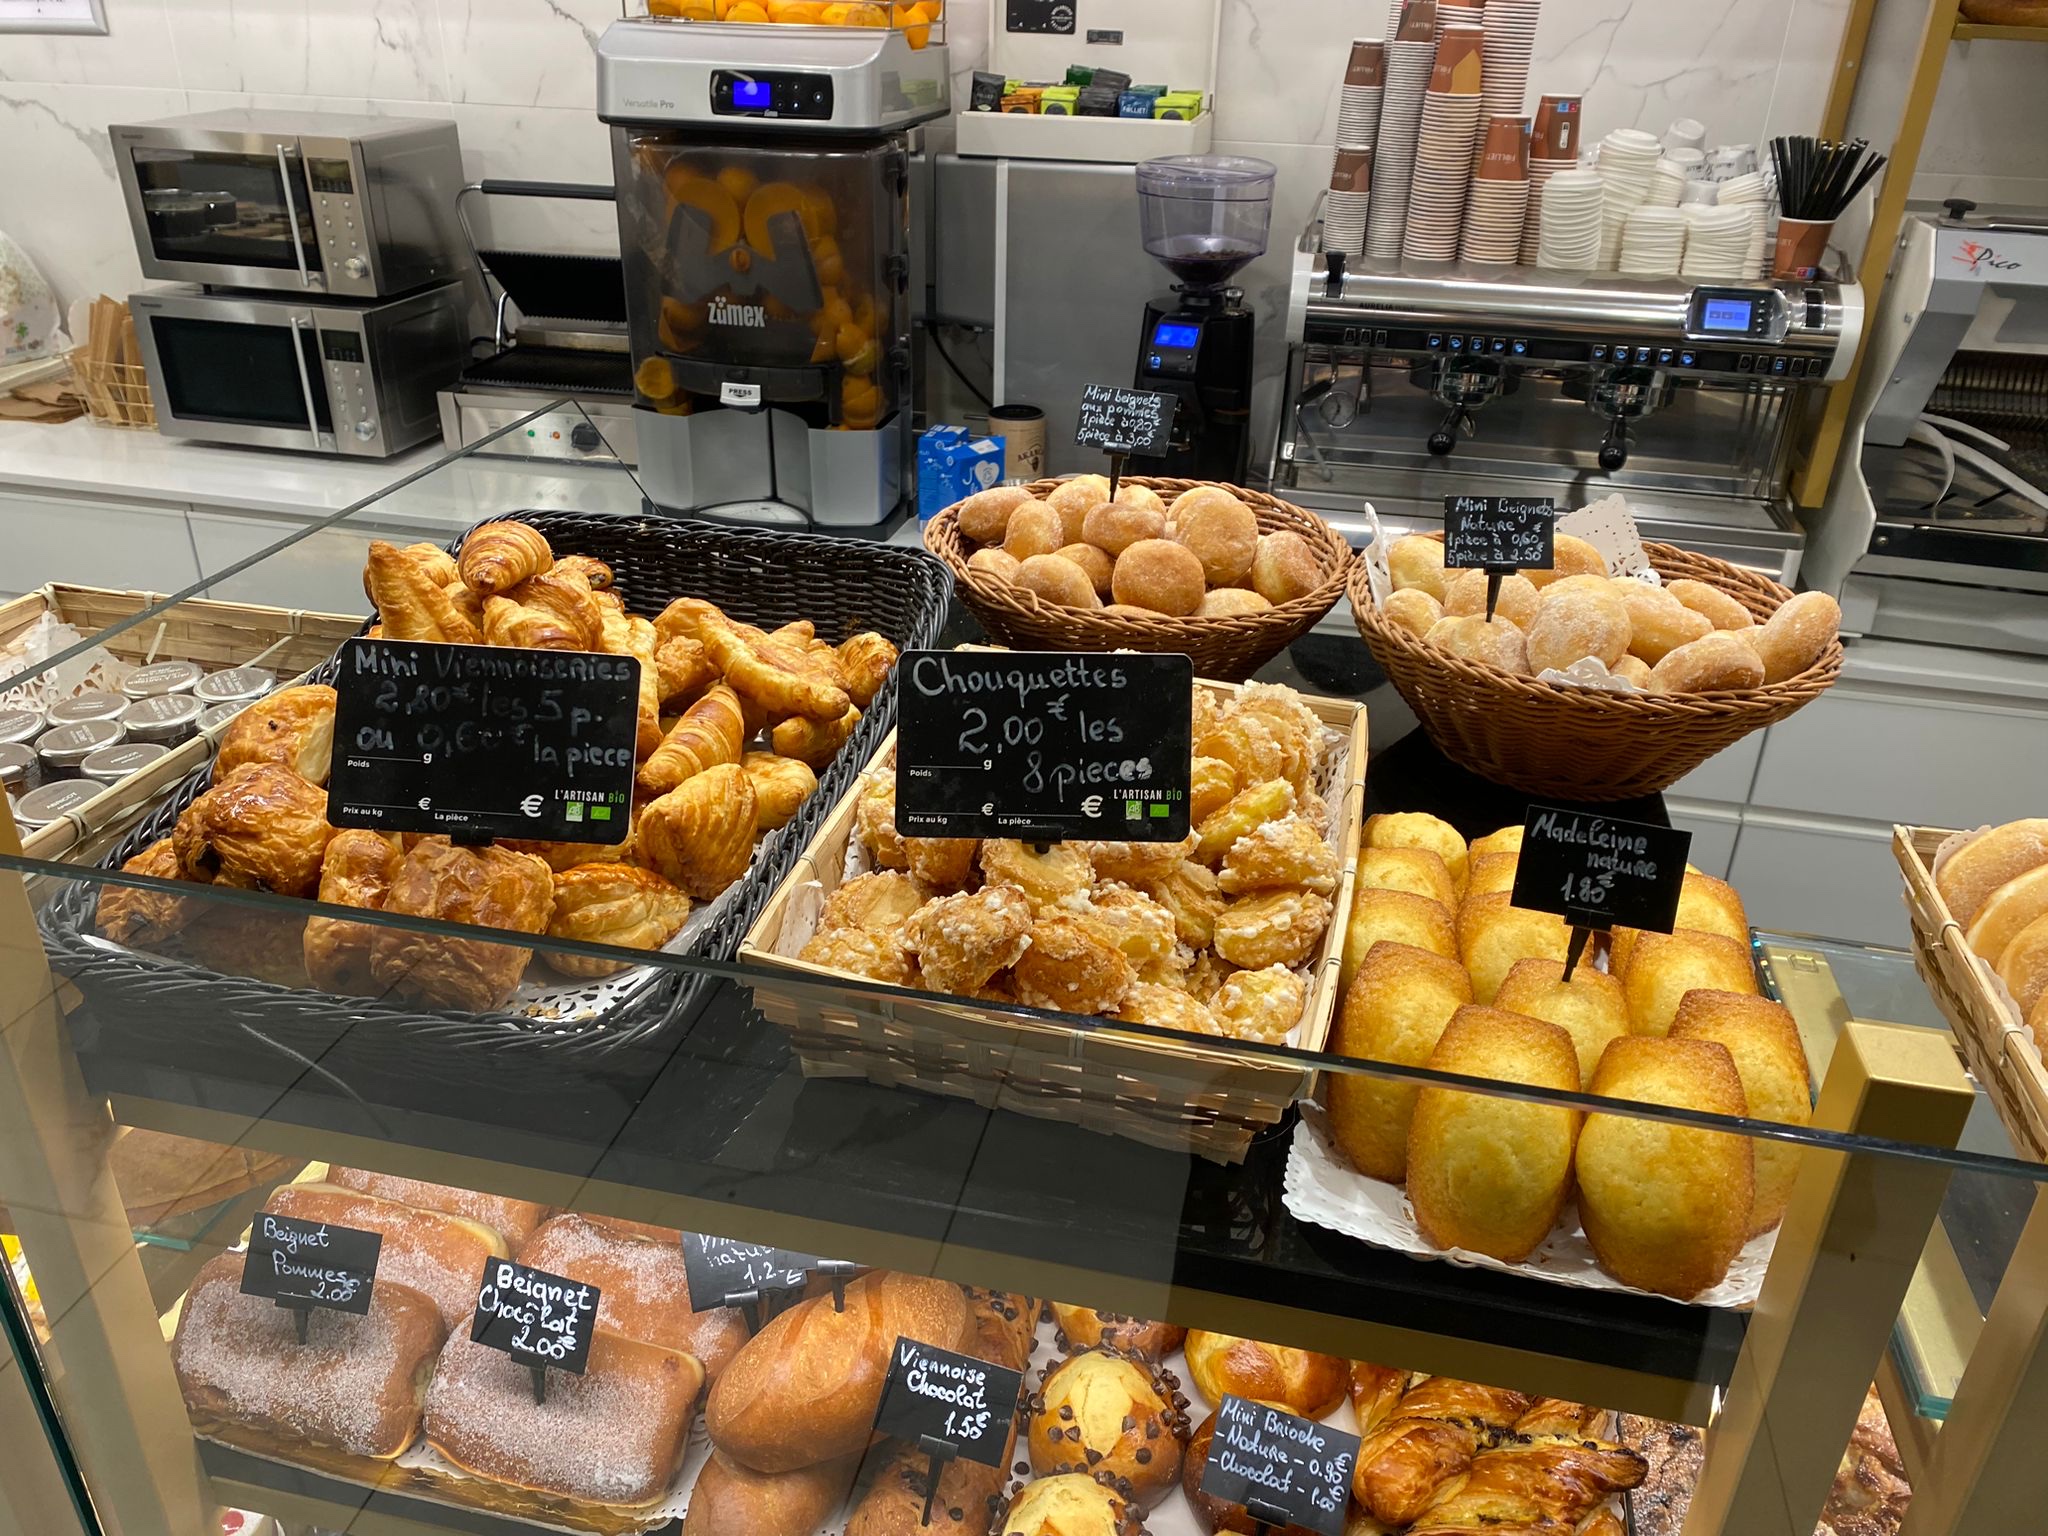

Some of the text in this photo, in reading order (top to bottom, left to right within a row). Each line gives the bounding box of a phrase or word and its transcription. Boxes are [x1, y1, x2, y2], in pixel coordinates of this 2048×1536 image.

[659, 99, 675, 109] Pro
[729, 388, 752, 396] PRESS
[1083, 385, 1161, 409] Mini beignets
[1081, 402, 1160, 419] aux pommes
[1115, 429, 1123, 442] à
[1455, 497, 1487, 512] Mini
[1492, 532, 1502, 545] à
[1494, 549, 1503, 560] à
[355, 644, 419, 677] Mini
[912, 657, 1128, 709] Chouquettes
[534, 689, 563, 722] 5
[569, 706, 603, 737] p.
[1080, 710, 1124, 743] les
[356, 726, 393, 751] ou
[533, 734, 560, 764] la
[347, 760, 370, 770] Poids
[423, 752, 432, 764] g
[983, 759, 992, 771] g
[909, 769, 932, 778] Poids
[1023, 751, 1044, 793] 8
[555, 789, 605, 803] L'ARTISAN
[1113, 789, 1163, 800] L'ARTISAN
[418, 797, 431, 811] €
[520, 794, 544, 818] €
[981, 803, 994, 817] €
[1080, 795, 1103, 818] €
[343, 807, 383, 818] Prix au kg
[435, 811, 469, 823] La pièce
[908, 815, 948, 826] Prix au kg
[998, 816, 1031, 827] La pièce
[1531, 812, 1648, 855] Madeleine
[263, 1216, 329, 1254] Beignet
[271, 1249, 348, 1286] Pommes
[496, 1264, 591, 1310] Beignet
[900, 1343, 986, 1386] Viennoise
[906, 1369, 987, 1410] Chocolat
[1221, 1398, 1257, 1427] Mini
[1220, 1451, 1293, 1494] Chocolat
